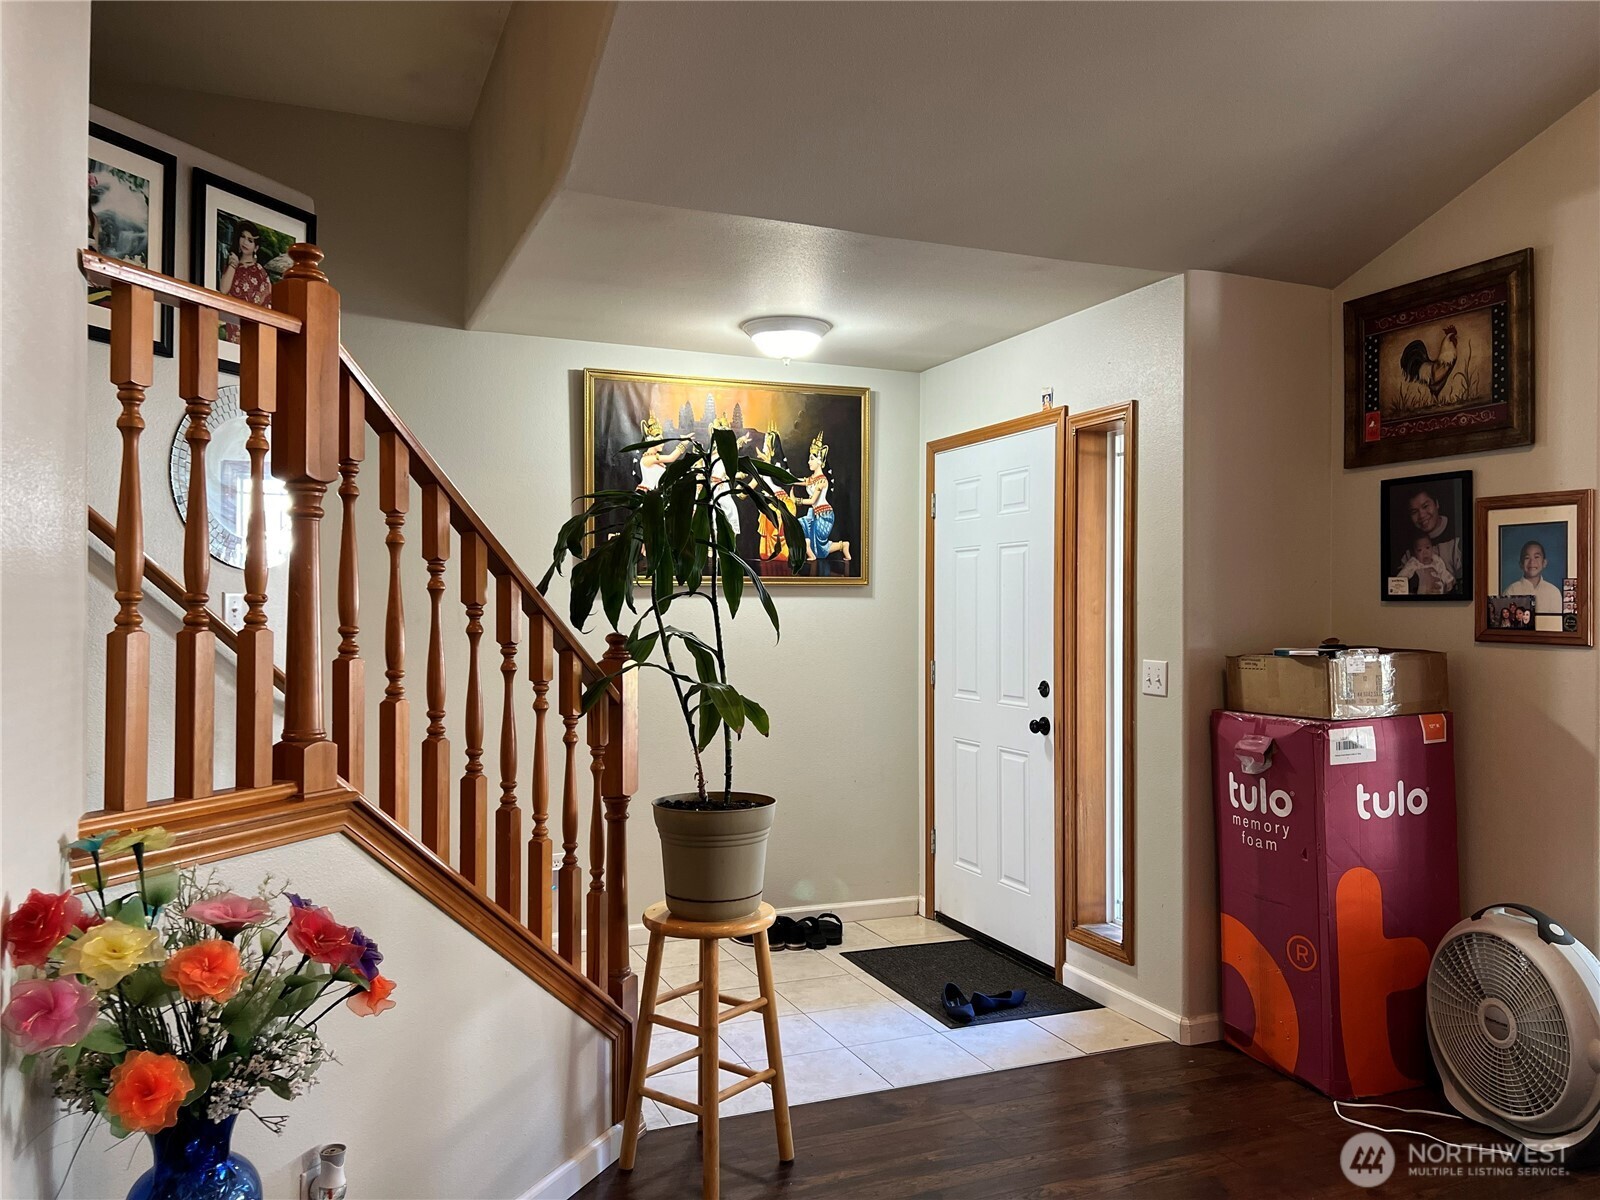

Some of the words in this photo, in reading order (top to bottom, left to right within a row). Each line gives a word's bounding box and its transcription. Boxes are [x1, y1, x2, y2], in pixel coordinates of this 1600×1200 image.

[1228, 771, 1293, 818] tulo
[1356, 780, 1428, 820] tulo
[1232, 814, 1290, 840] memory
[1241, 830, 1278, 852] foam
